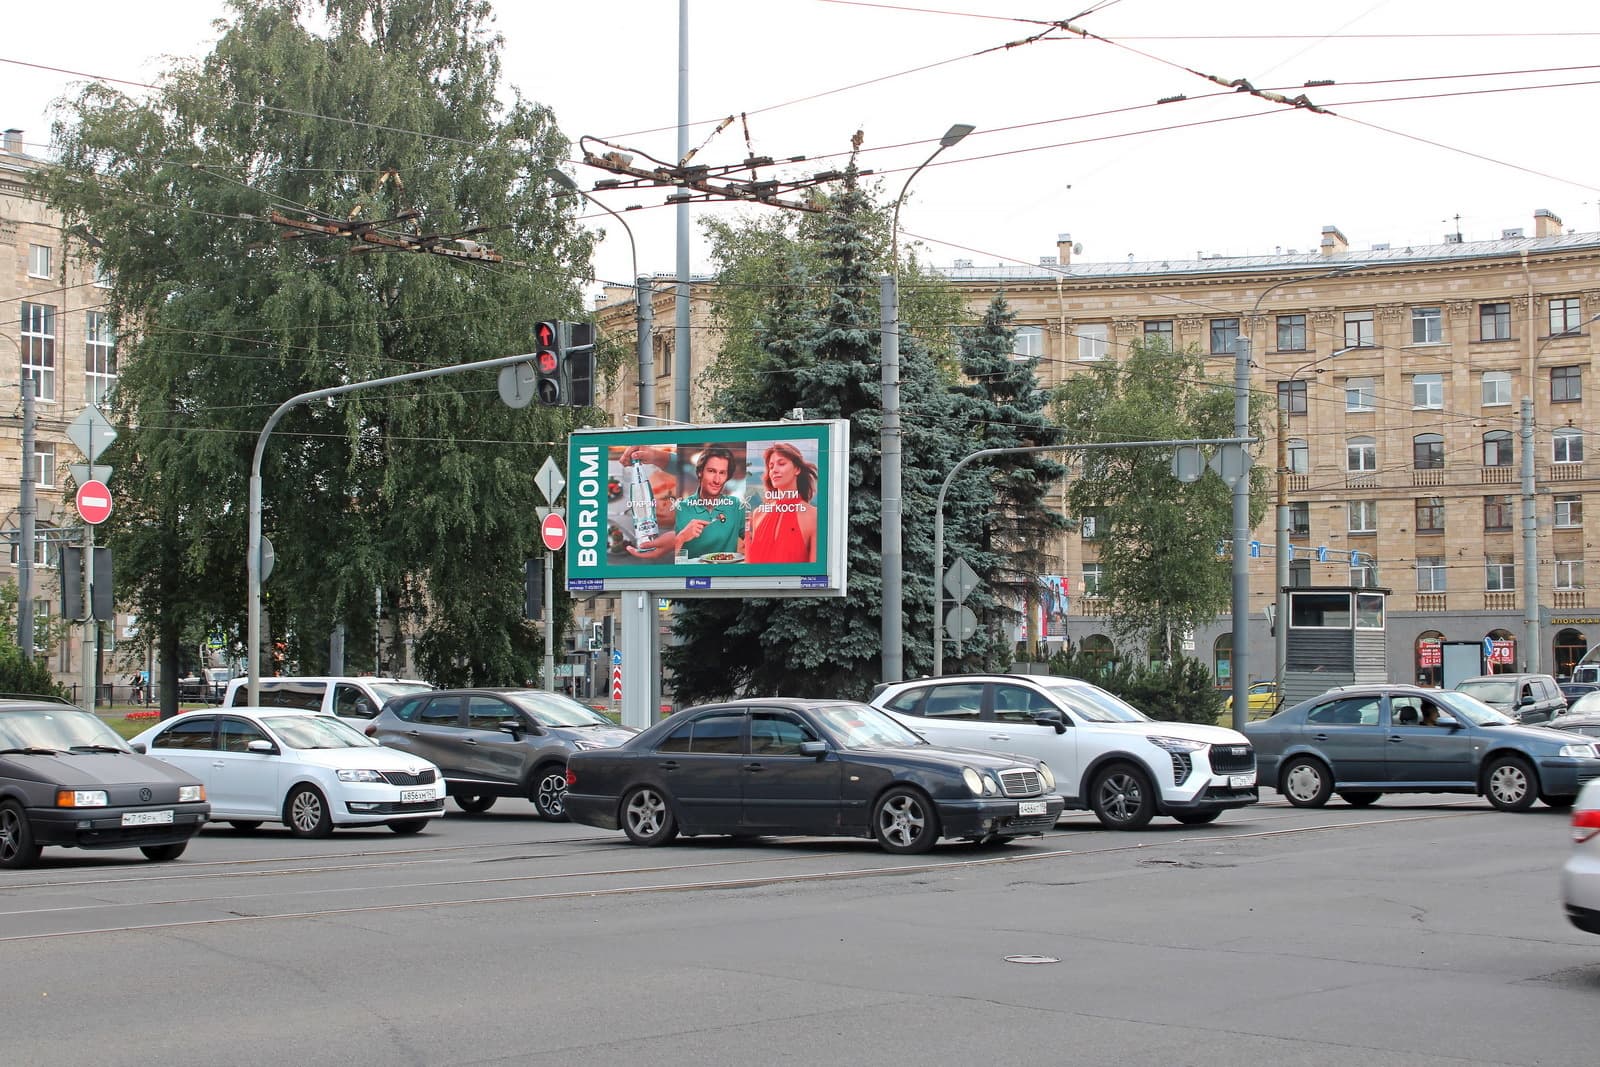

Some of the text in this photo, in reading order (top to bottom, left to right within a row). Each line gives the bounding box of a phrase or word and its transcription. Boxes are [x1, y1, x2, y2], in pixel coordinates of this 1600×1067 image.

[764, 490, 799, 500] ОЩУТИ
[577, 446, 600, 567] BORJOMI
[626, 499, 657, 508] ОТКРОЙ
[687, 498, 734, 507] НАСЛАДИСЬ
[758, 501, 807, 513] ЛЁГКОСТЬ
[1493, 647, 1510, 657] 70
